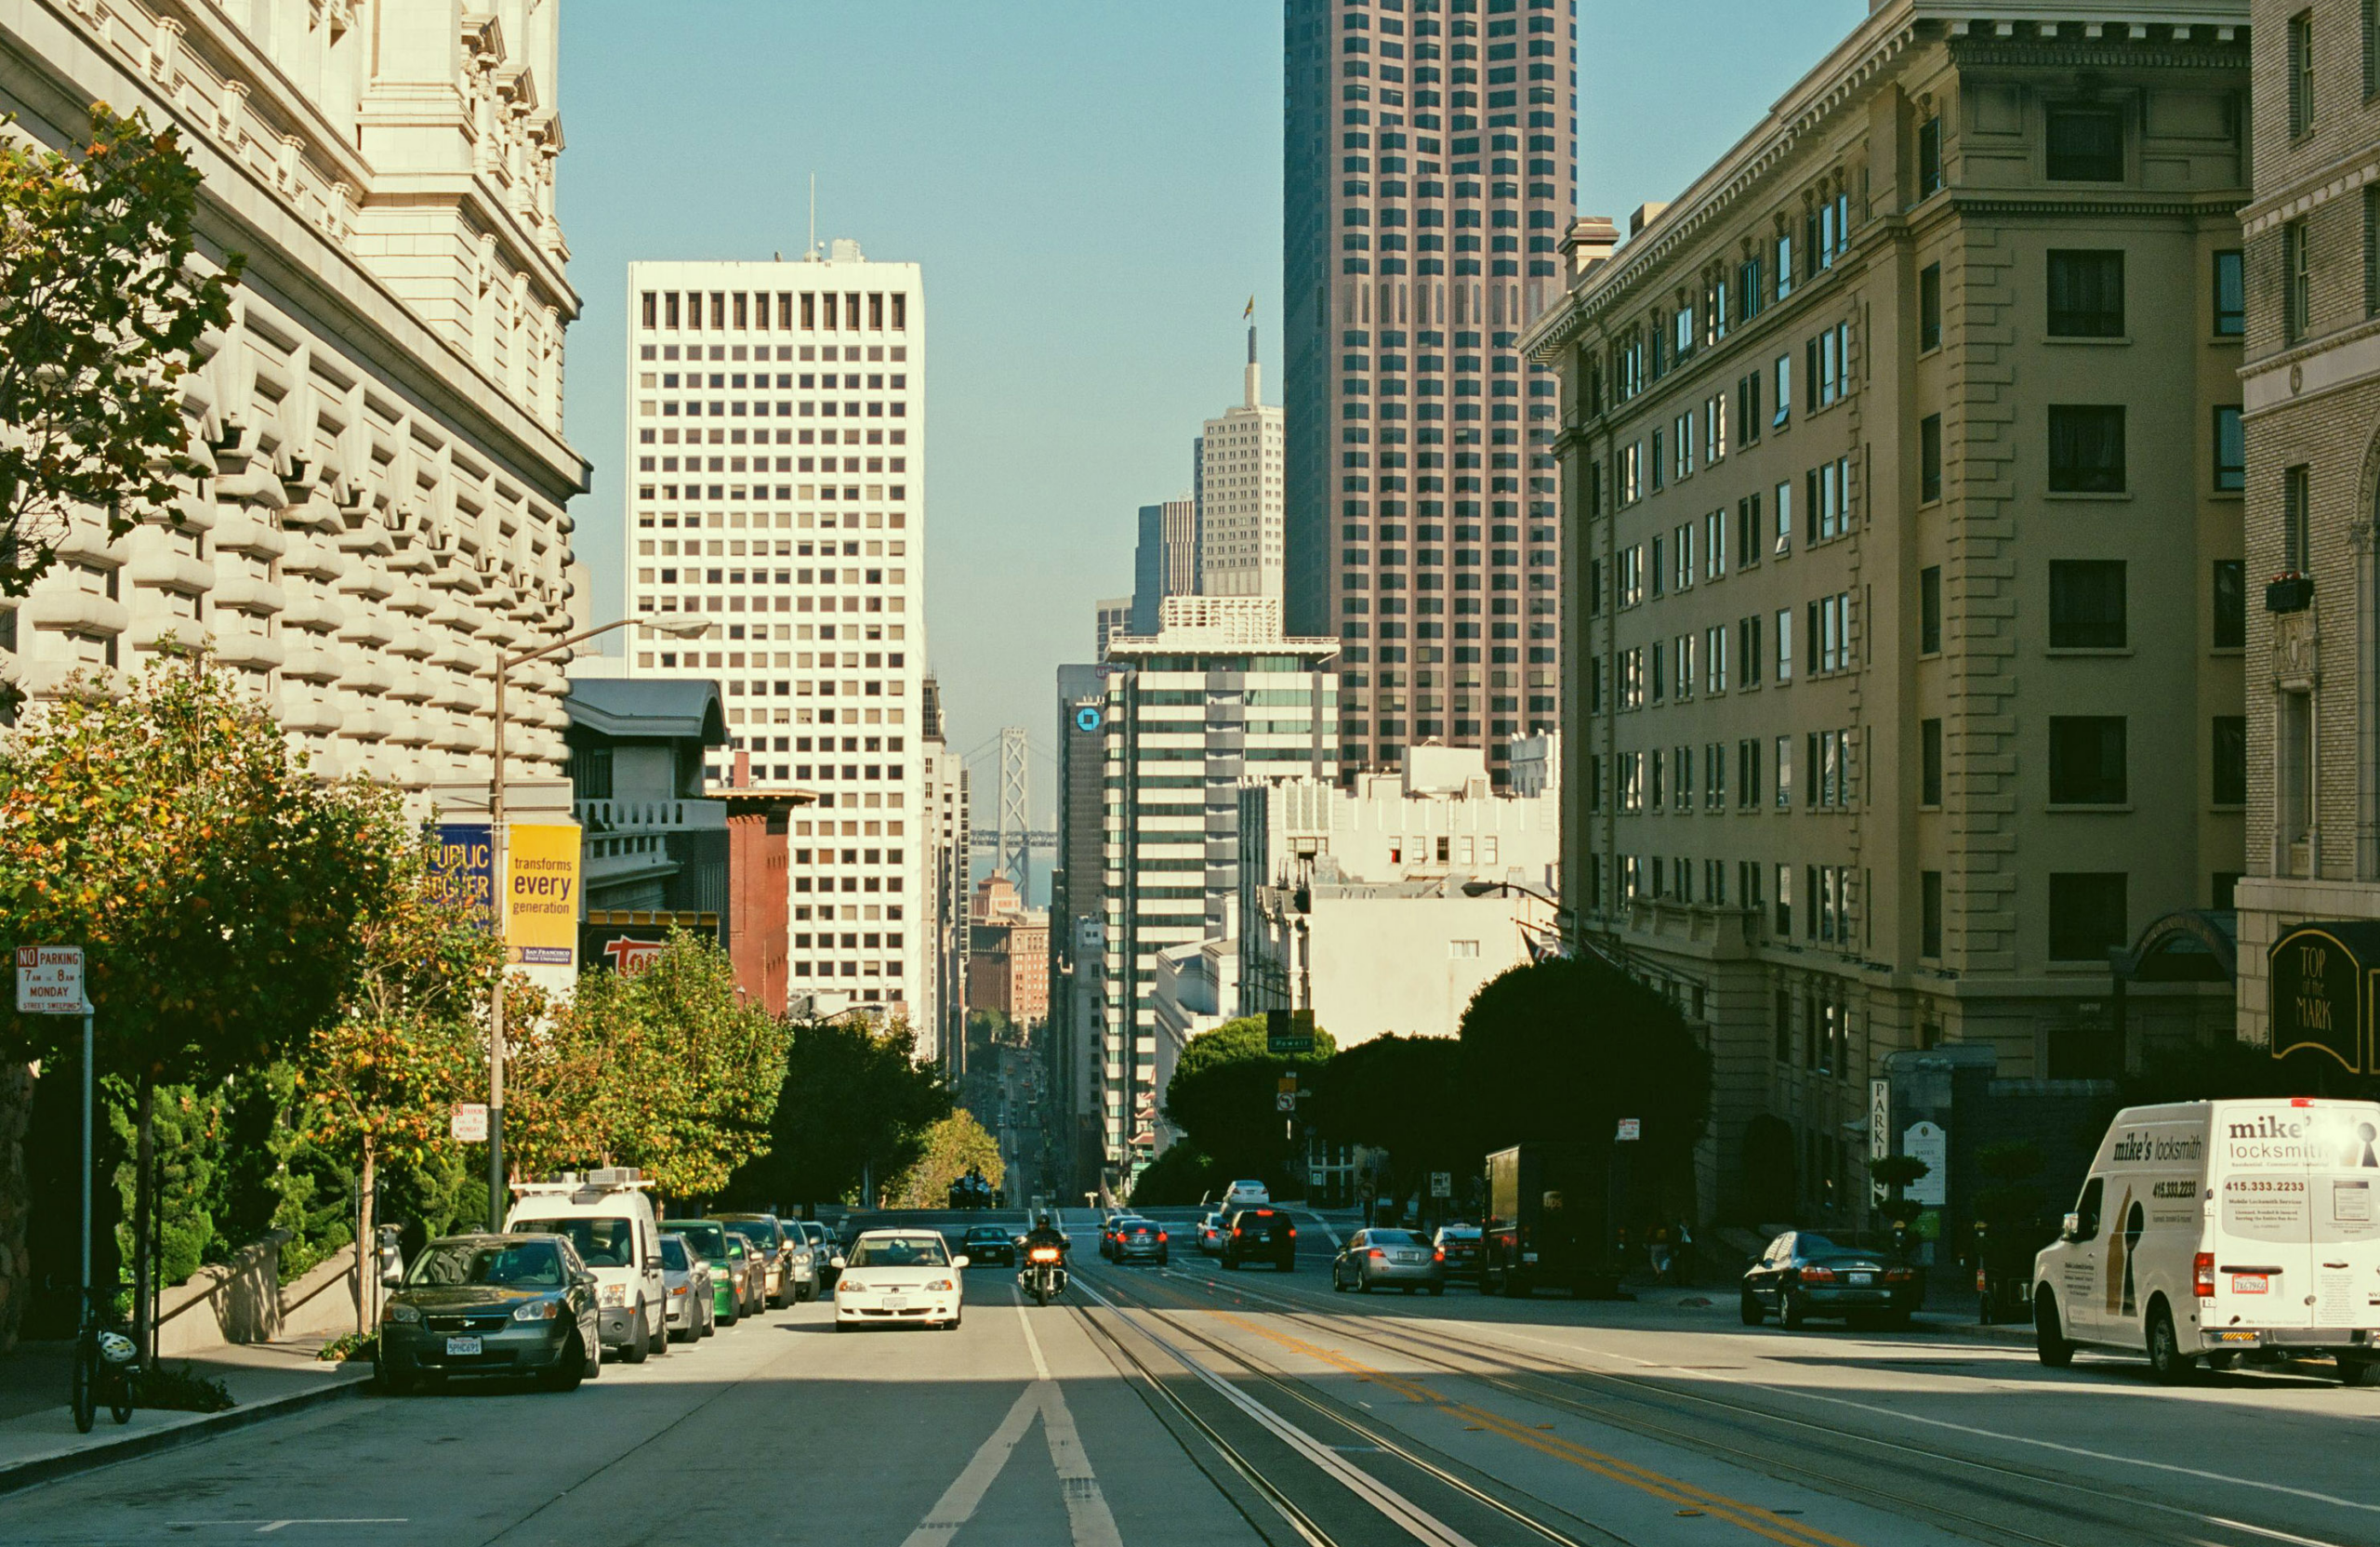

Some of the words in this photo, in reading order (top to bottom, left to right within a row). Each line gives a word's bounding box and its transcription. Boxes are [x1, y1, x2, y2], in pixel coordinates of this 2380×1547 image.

[515, 857, 572, 871] transforms
[514, 876, 571, 901] every
[513, 902, 570, 916] generation
[20, 948, 35, 966] NO
[40, 952, 79, 965] PARKING
[538, 948, 571, 957] FRANCISCO
[2299, 946, 2326, 978] TOP
[30, 986, 70, 998] MONDAY
[2302, 979, 2310, 995] of
[2312, 979, 2325, 998] the
[2295, 996, 2333, 1031] MARK
[1874, 1083, 1884, 1191] PARKIG
[2113, 1131, 2152, 1161] mike's
[2154, 1135, 2202, 1161] locksmith
[2152, 1180, 2197, 1199] 415.333.2233
[2225, 1182, 2305, 1192] 415.333.2233
